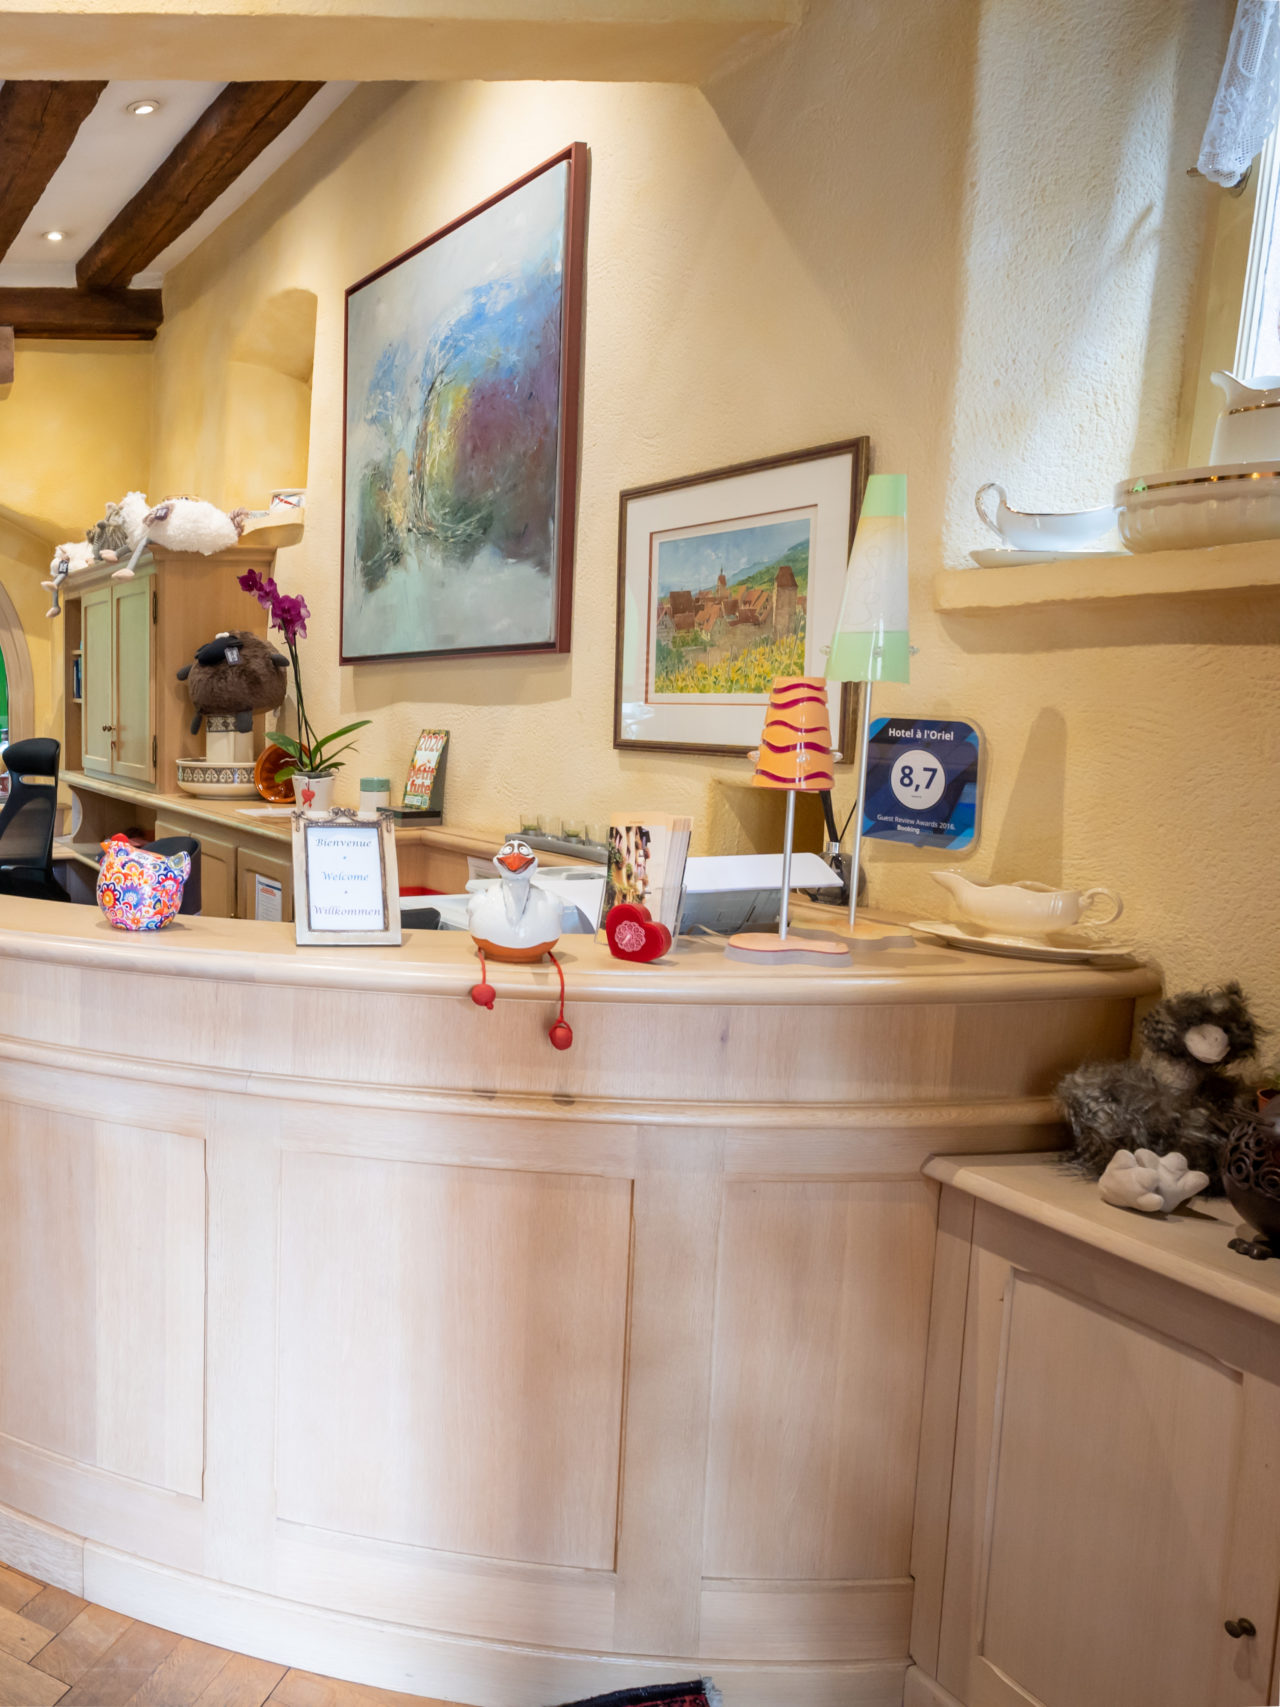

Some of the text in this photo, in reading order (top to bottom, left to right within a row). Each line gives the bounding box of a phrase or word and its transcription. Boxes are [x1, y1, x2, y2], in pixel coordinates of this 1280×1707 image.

[888, 728, 954, 741] Hotel à l'Oriel
[417, 734, 444, 752] 2020
[899, 765, 938, 792] 8,7
[876, 814, 894, 822] Guest
[894, 816, 915, 825] Review
[915, 819, 938, 828] Awards
[315, 838, 372, 848] Bienvenue
[321, 871, 369, 881] Welcome
[312, 905, 381, 916] Willkommen
